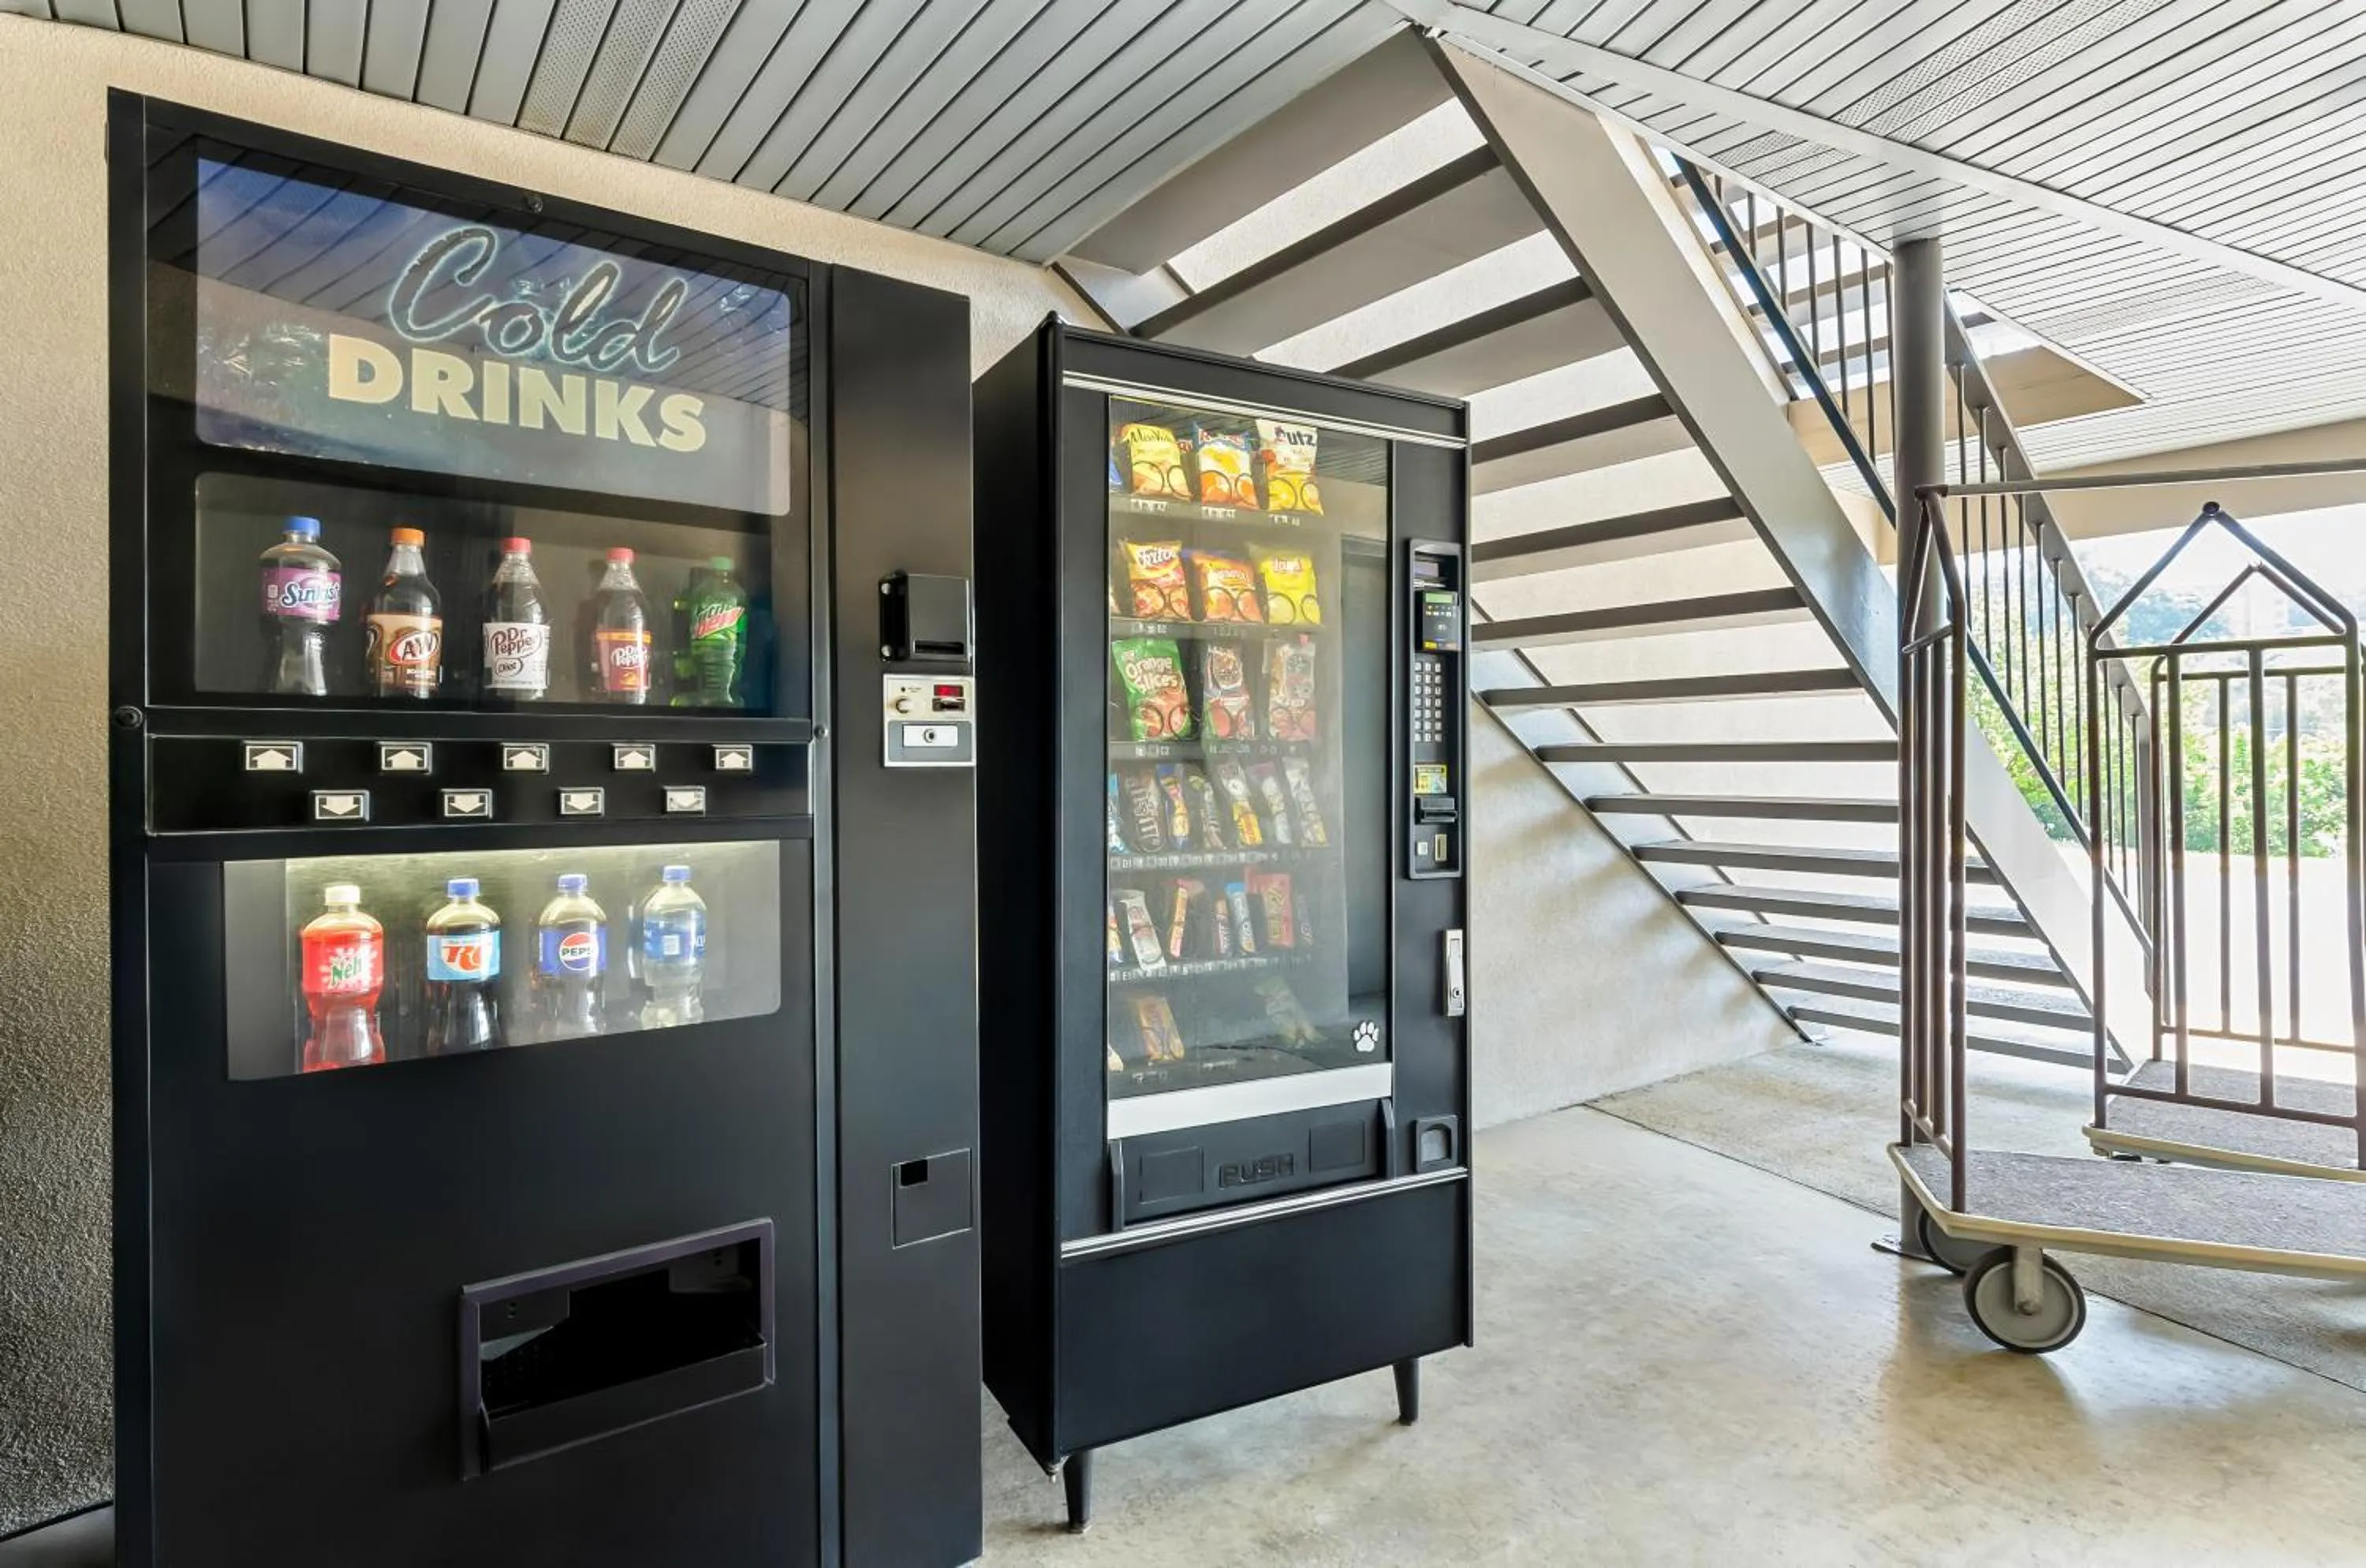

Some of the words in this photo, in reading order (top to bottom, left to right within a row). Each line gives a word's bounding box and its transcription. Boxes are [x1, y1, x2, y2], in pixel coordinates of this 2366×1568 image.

[387, 226, 689, 372] Cold
[327, 334, 707, 453] DRINKS
[507, 627, 528, 641] Dr
[1125, 656, 1173, 680] Orange
[562, 946, 592, 957] PEPS
[1218, 1152, 1294, 1188] PUSH
